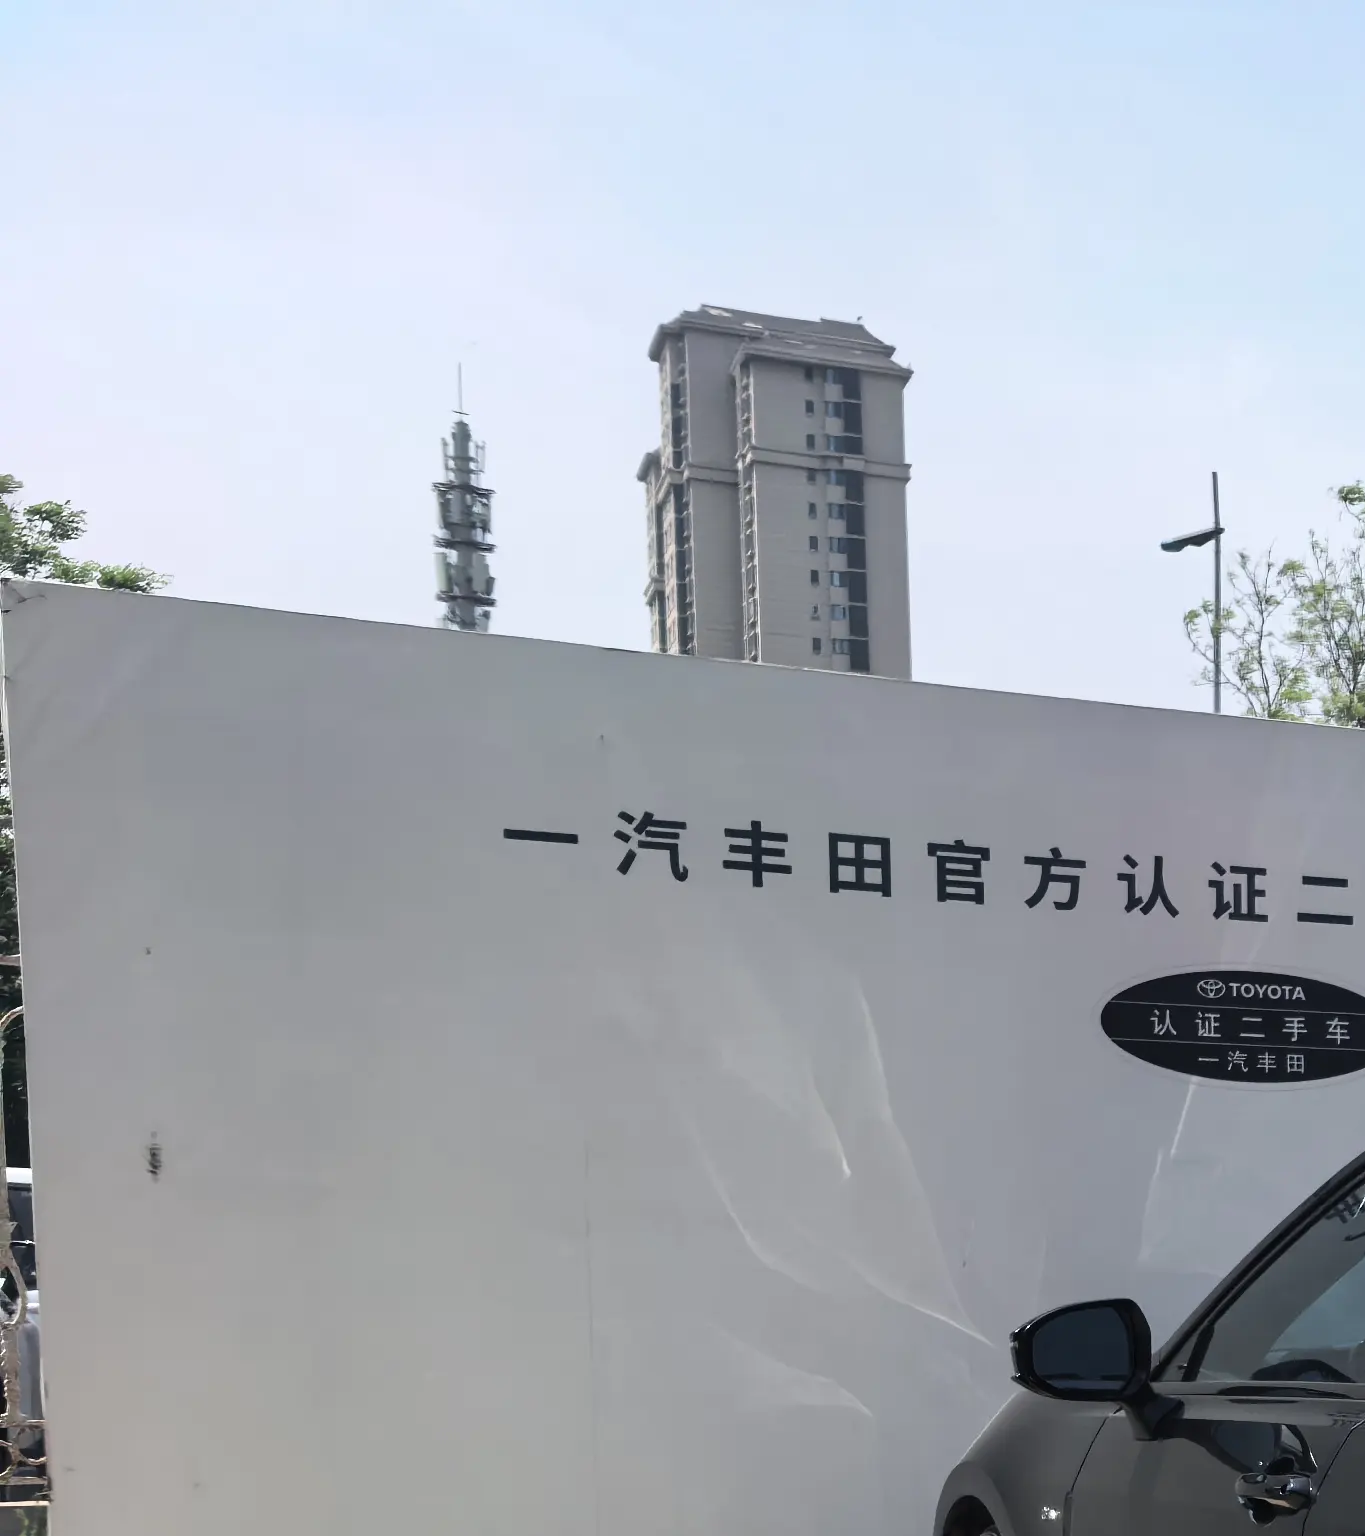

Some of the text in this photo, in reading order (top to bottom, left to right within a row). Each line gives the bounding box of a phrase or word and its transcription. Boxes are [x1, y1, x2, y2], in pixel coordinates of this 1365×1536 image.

[1229, 983, 1306, 1001] TOYOTA
[1150, 1009, 1351, 1045] 认证二手车
[1198, 1050, 1306, 1075] 一汽丰田
